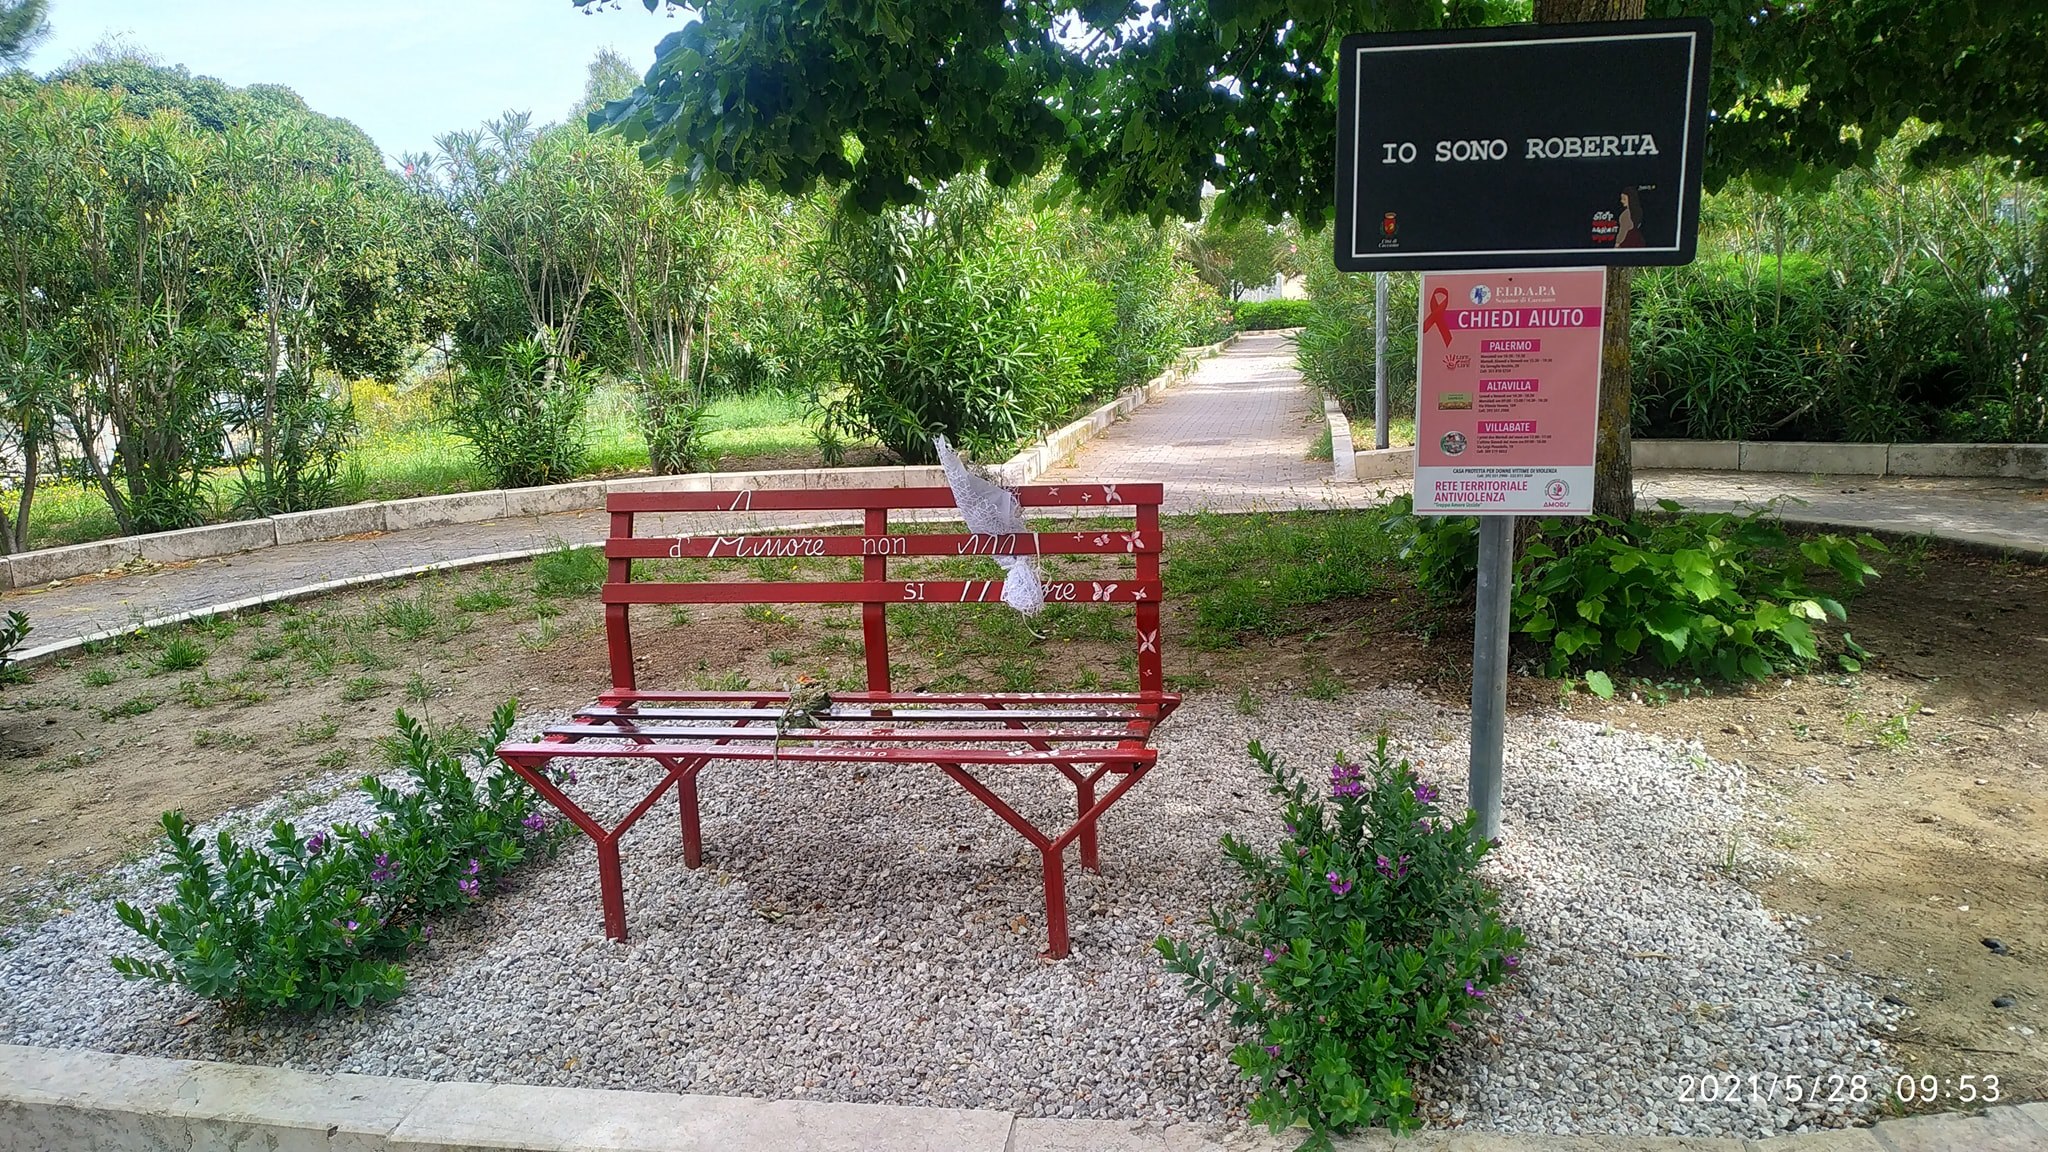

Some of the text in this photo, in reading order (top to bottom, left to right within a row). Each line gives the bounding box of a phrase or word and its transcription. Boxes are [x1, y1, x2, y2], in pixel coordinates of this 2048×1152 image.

[1381, 133, 1660, 164] IO SONO ROBERTA
[1457, 308, 1584, 329] CHIEDI AIUTO
[1489, 341, 1532, 351] PALERMO
[1486, 381, 1531, 391] ALTAVILLA
[1484, 422, 1530, 433] VILLABATE
[1435, 480, 1528, 491] RETE TERRITORIALE
[1434, 492, 1506, 502] ANTIVIOLENZA
[861, 537, 906, 555] non
